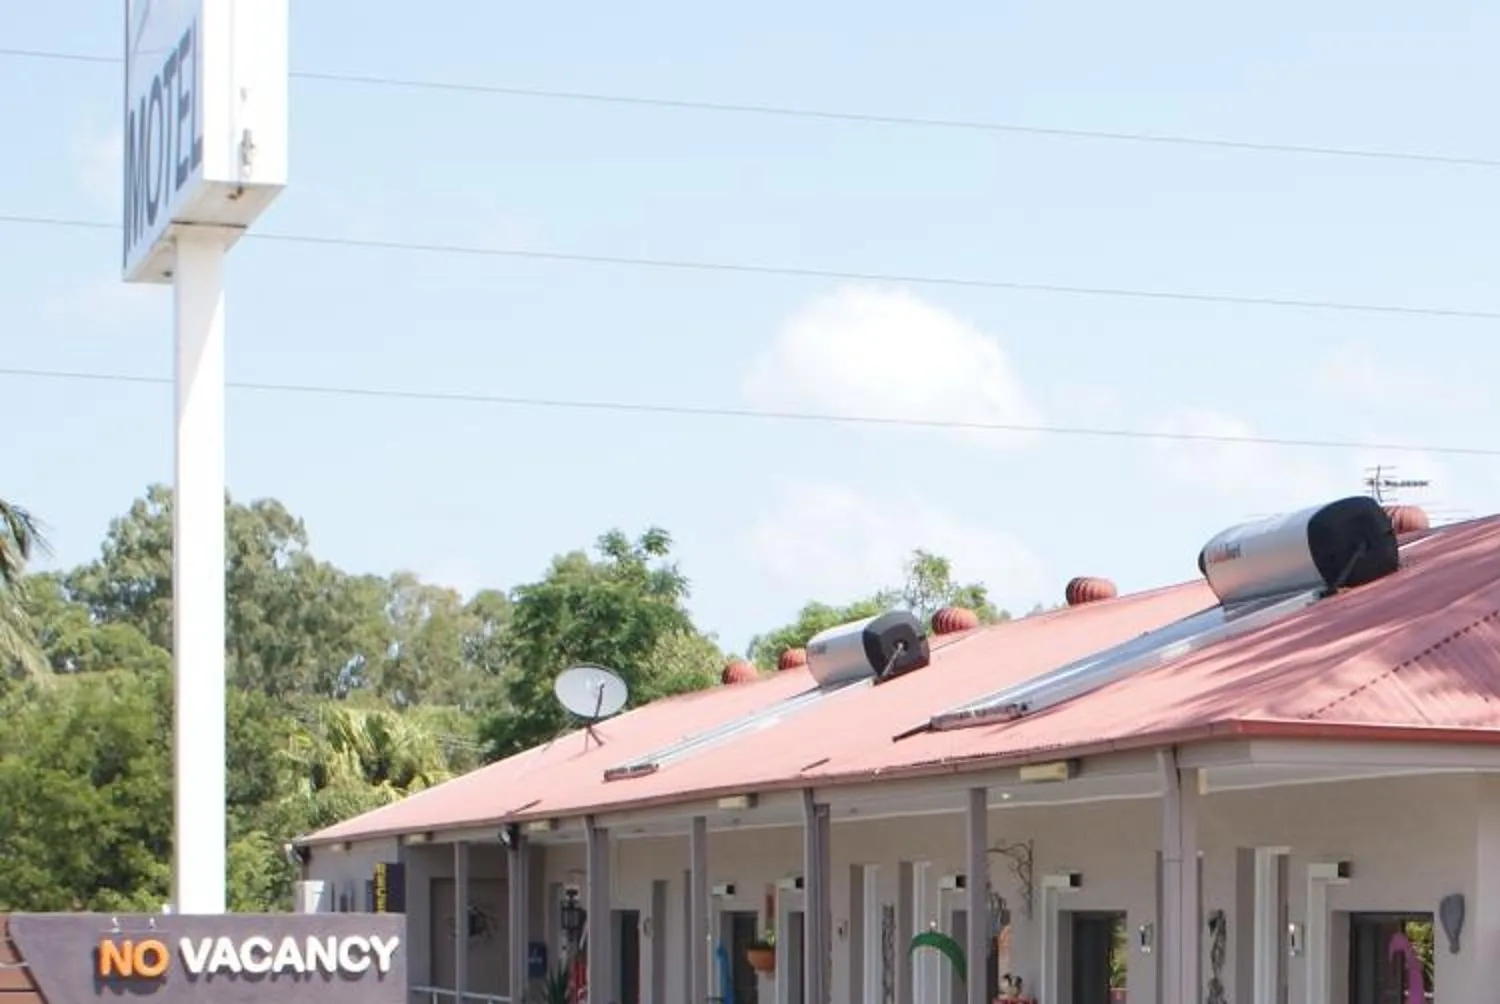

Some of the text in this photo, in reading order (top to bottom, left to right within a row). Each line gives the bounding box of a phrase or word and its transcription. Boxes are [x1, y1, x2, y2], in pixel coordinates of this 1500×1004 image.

[126, 16, 203, 250] MOTEL
[98, 935, 400, 978] NO VACANCY
